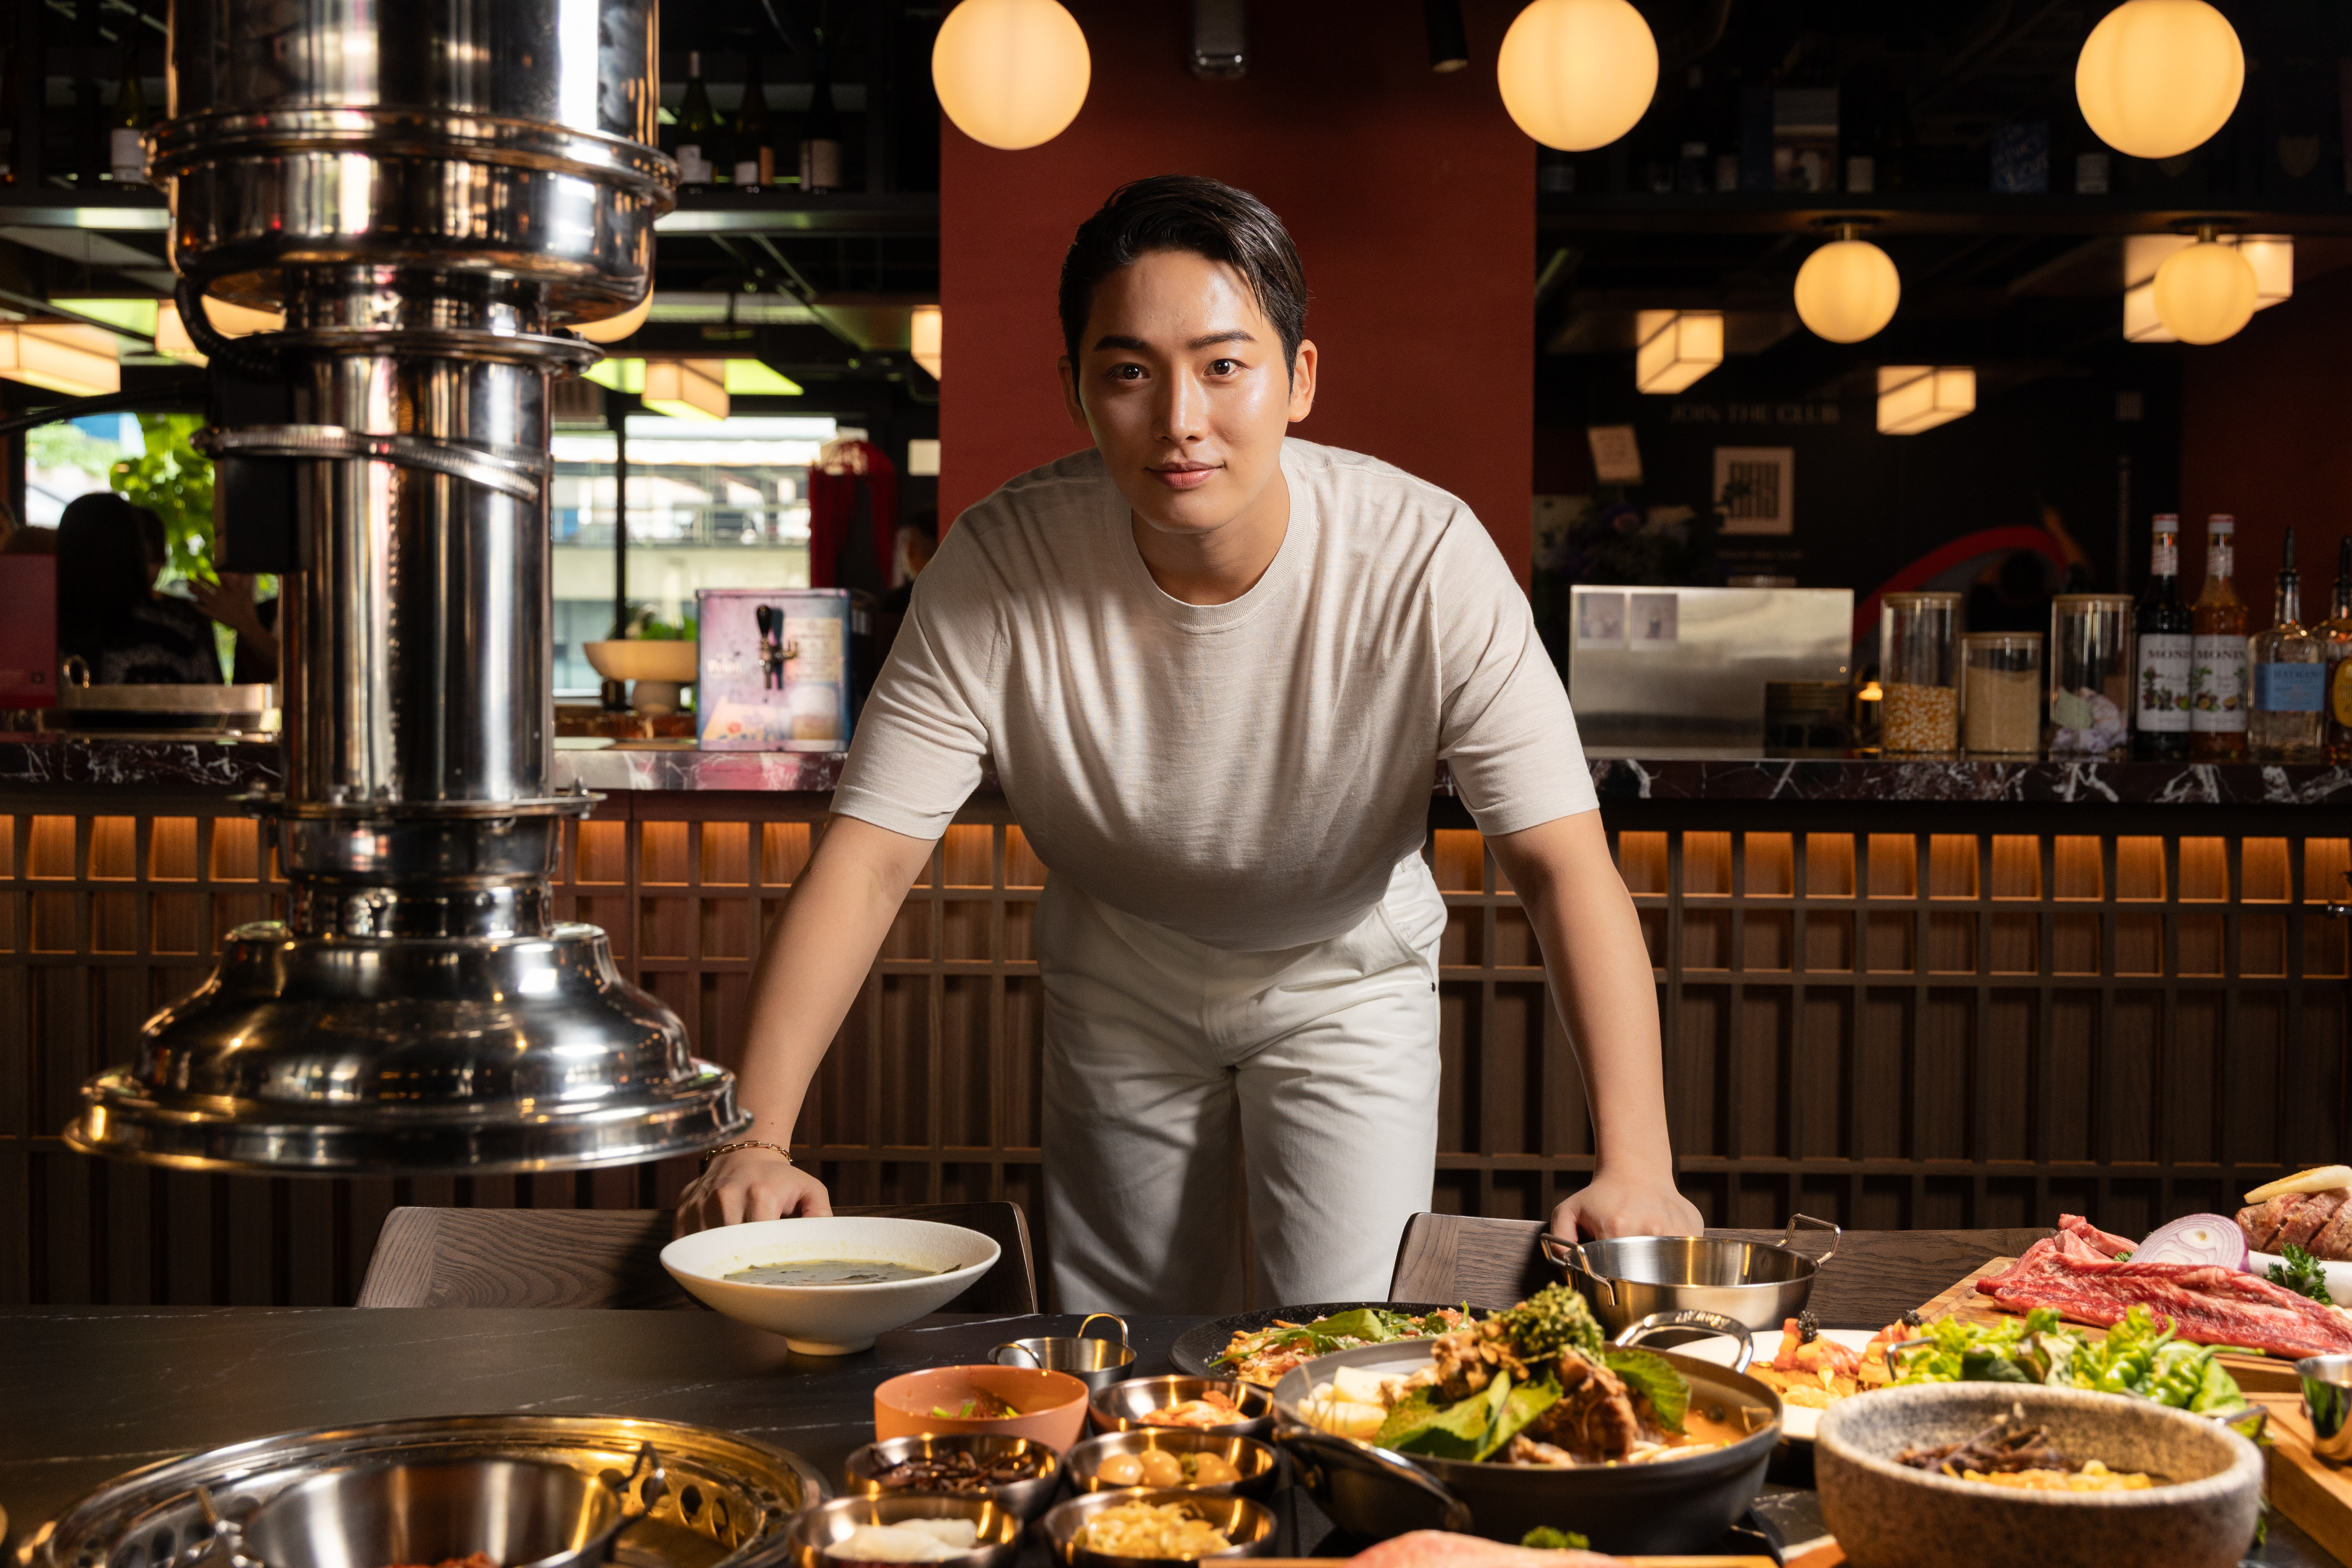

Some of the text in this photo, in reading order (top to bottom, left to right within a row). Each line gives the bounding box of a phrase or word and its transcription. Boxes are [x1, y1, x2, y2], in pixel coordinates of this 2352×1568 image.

[1670, 403, 1840, 424] JOIN THE CLUB
[2147, 649, 2190, 660] MONI
